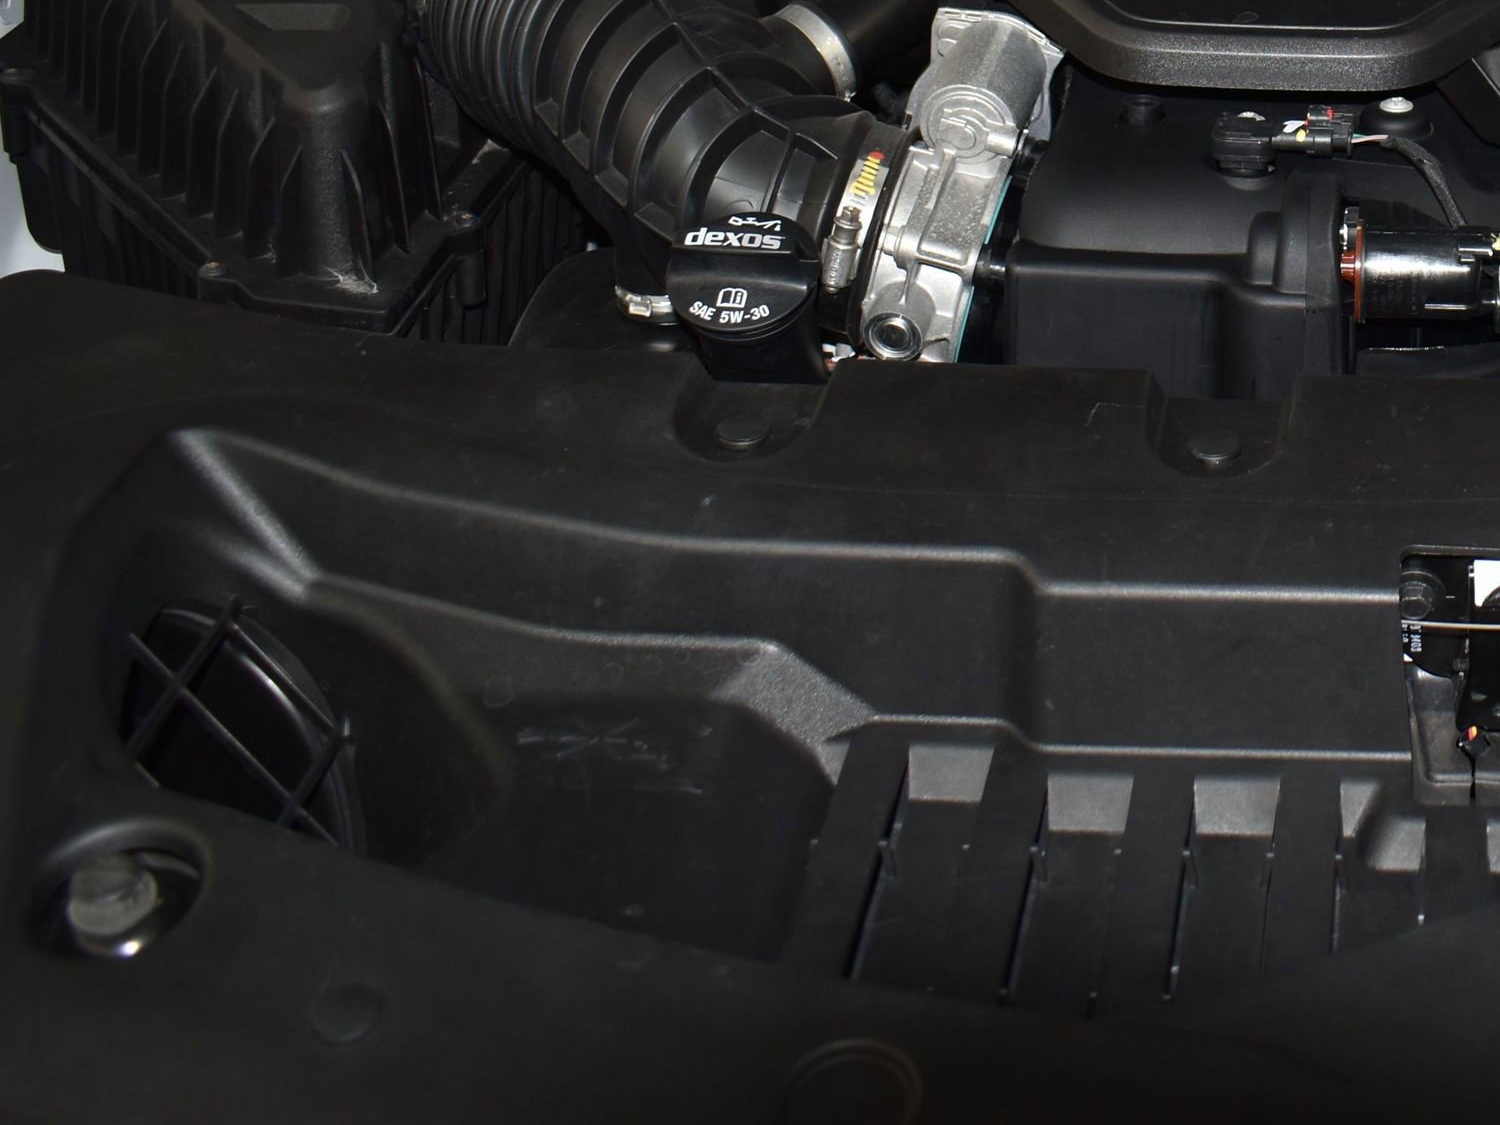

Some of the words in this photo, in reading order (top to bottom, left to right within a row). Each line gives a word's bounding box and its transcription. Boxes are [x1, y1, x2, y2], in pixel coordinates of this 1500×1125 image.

[684, 227, 782, 250] dexos
[689, 301, 716, 321] SAE
[719, 304, 770, 324] 5W-30
